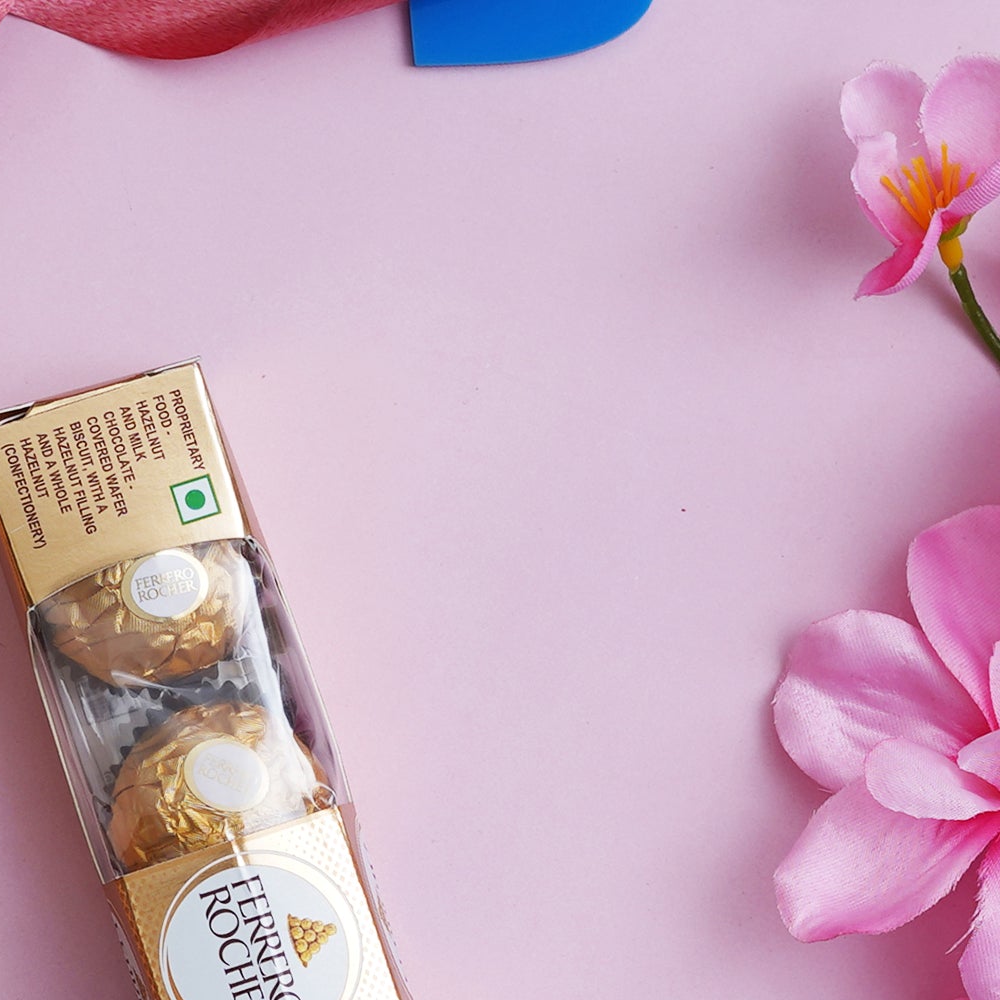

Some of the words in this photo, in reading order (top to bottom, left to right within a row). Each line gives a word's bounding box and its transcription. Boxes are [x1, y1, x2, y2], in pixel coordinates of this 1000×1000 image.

[119, 406, 137, 431] AND
[128, 432, 147, 462] MILK
[136, 400, 165, 460] HAZELNUT
[153, 394, 172, 428] FOOD
[169, 389, 205, 470] PROPRIETARY
[19, 437, 50, 498] HAZELNUT
[36, 433, 54, 458] AND
[45, 461, 57, 470] A
[69, 421, 94, 472] BISCUIT,
[86, 471, 106, 502] WITH
[96, 505, 108, 514] A
[87, 416, 114, 472] COVERED
[105, 473, 128, 517] WAFER
[103, 411, 136, 483] CHOCOLATE
[0, 443, 47, 549] (CONFECTIONERY)
[49, 469, 72, 514] WHOLE
[53, 426, 83, 487] HAZELNUT
[73, 489, 97, 535] FILLING
[135, 567, 194, 590] FERRERO
[137, 580, 198, 603] ROCHER
